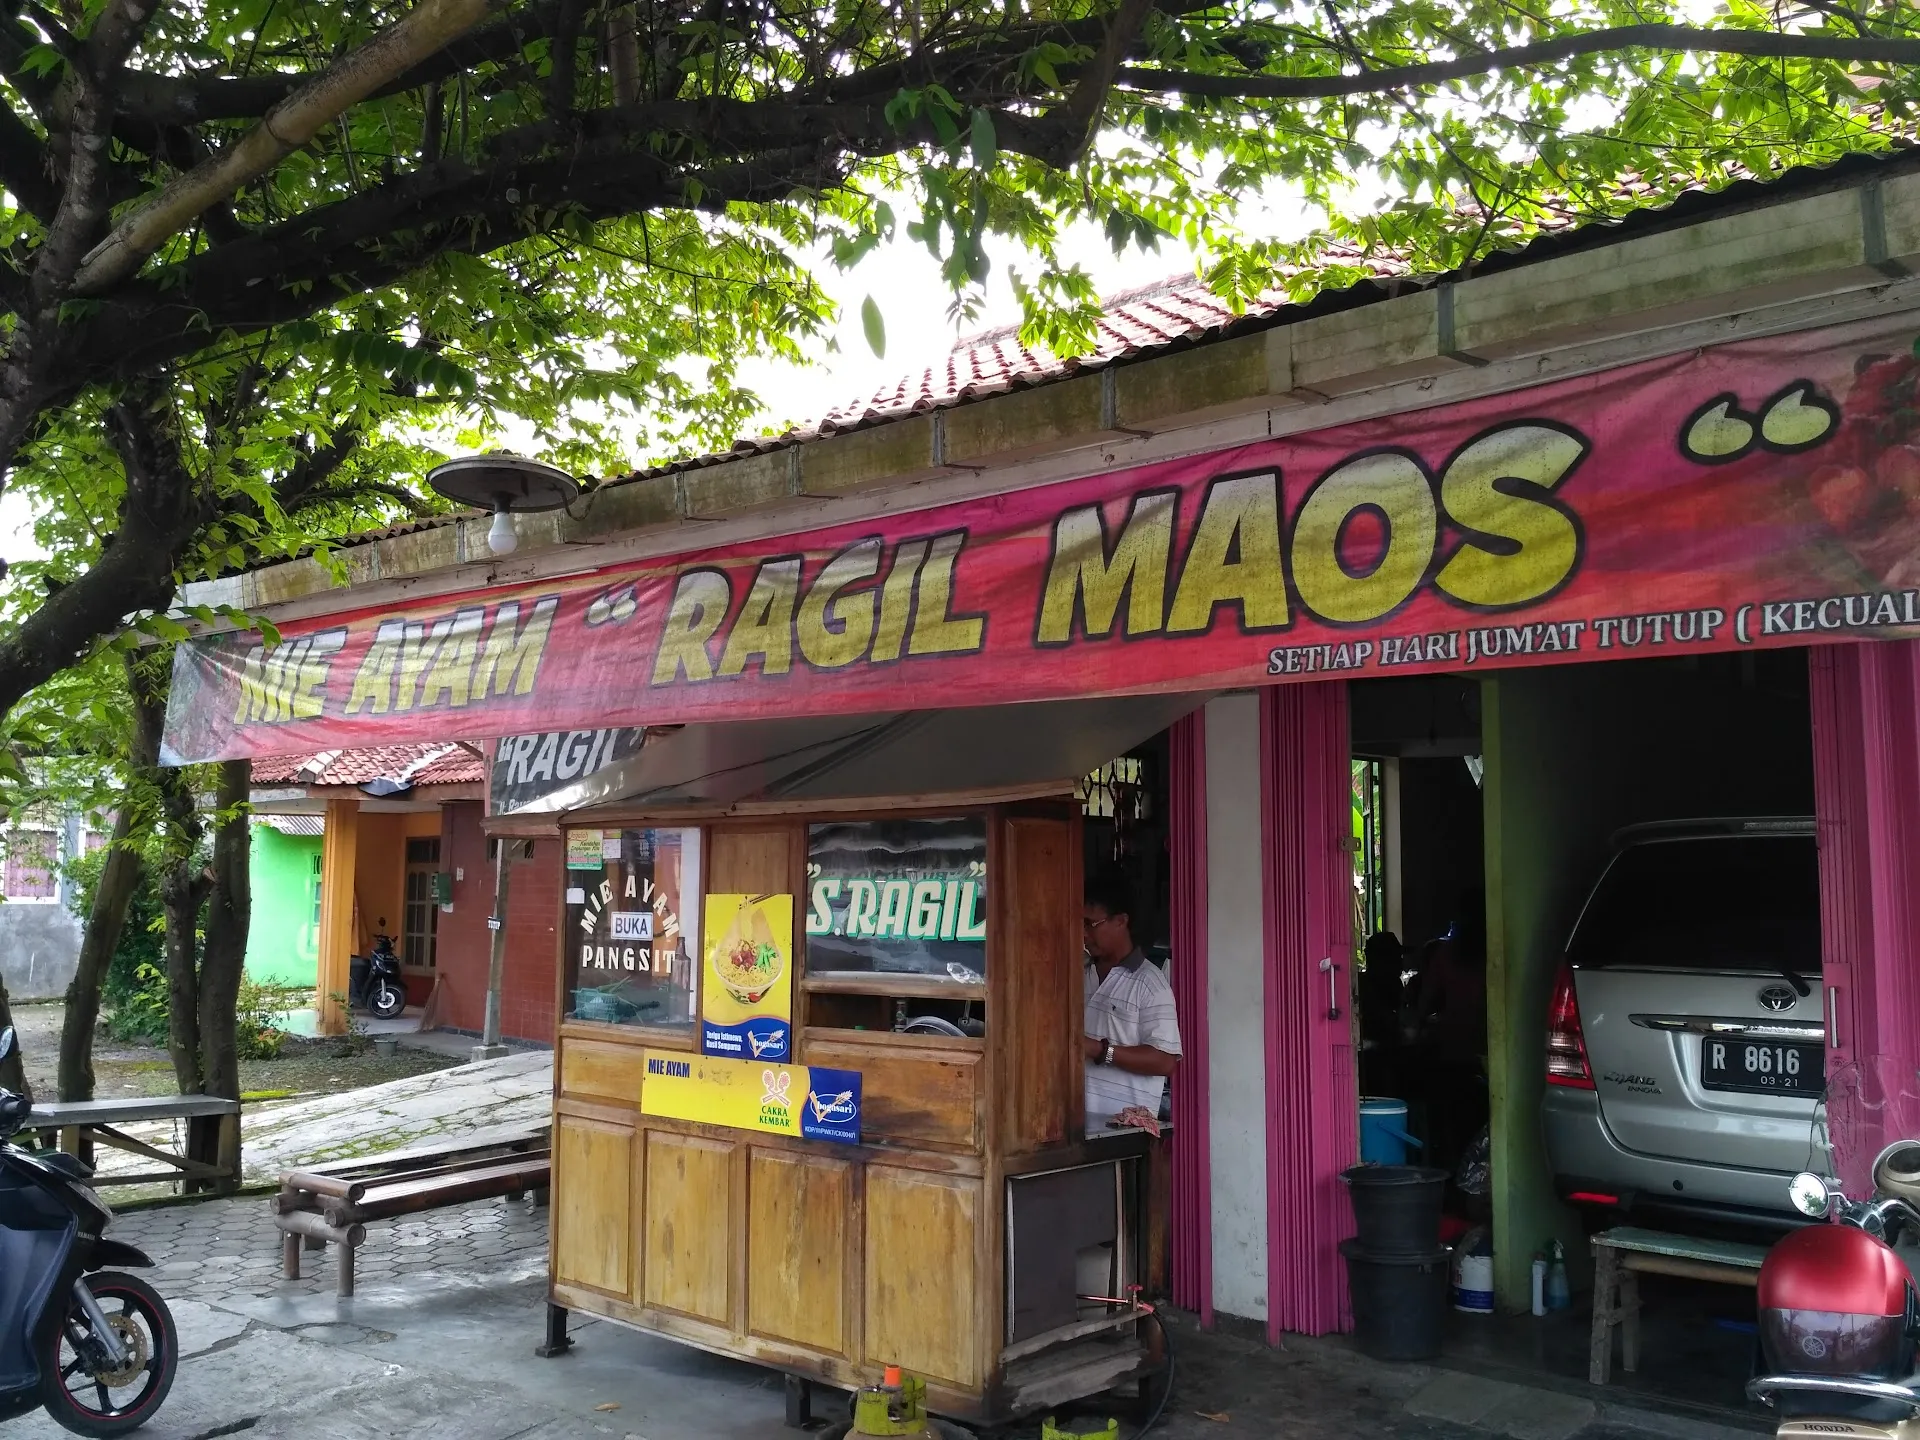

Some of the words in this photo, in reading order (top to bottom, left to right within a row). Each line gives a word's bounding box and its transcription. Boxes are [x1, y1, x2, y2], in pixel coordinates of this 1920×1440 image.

[232, 627, 348, 725] MIE
[343, 596, 561, 716] AYAM
[651, 528, 989, 687] RAGIL
[1034, 417, 1592, 648] MAOS
[1266, 641, 1373, 676] SETIAP
[1379, 632, 1459, 666] HARI
[1593, 607, 1725, 649] TUTUP
[580, 879, 614, 935] MIE
[625, 875, 680, 938] AYAM
[615, 917, 649, 935] BUKA
[582, 945, 675, 974] PANGSIT
[648, 1058, 664, 1076] MIE
[666, 1061, 690, 1079] AYAM
[1712, 1043, 1726, 1070] R
[1744, 1046, 1800, 1075] 8616
[759, 1115, 791, 1128] KEMBAR
[761, 1105, 788, 1117] CAKRA
[1803, 1423, 1856, 1433] HONDA
